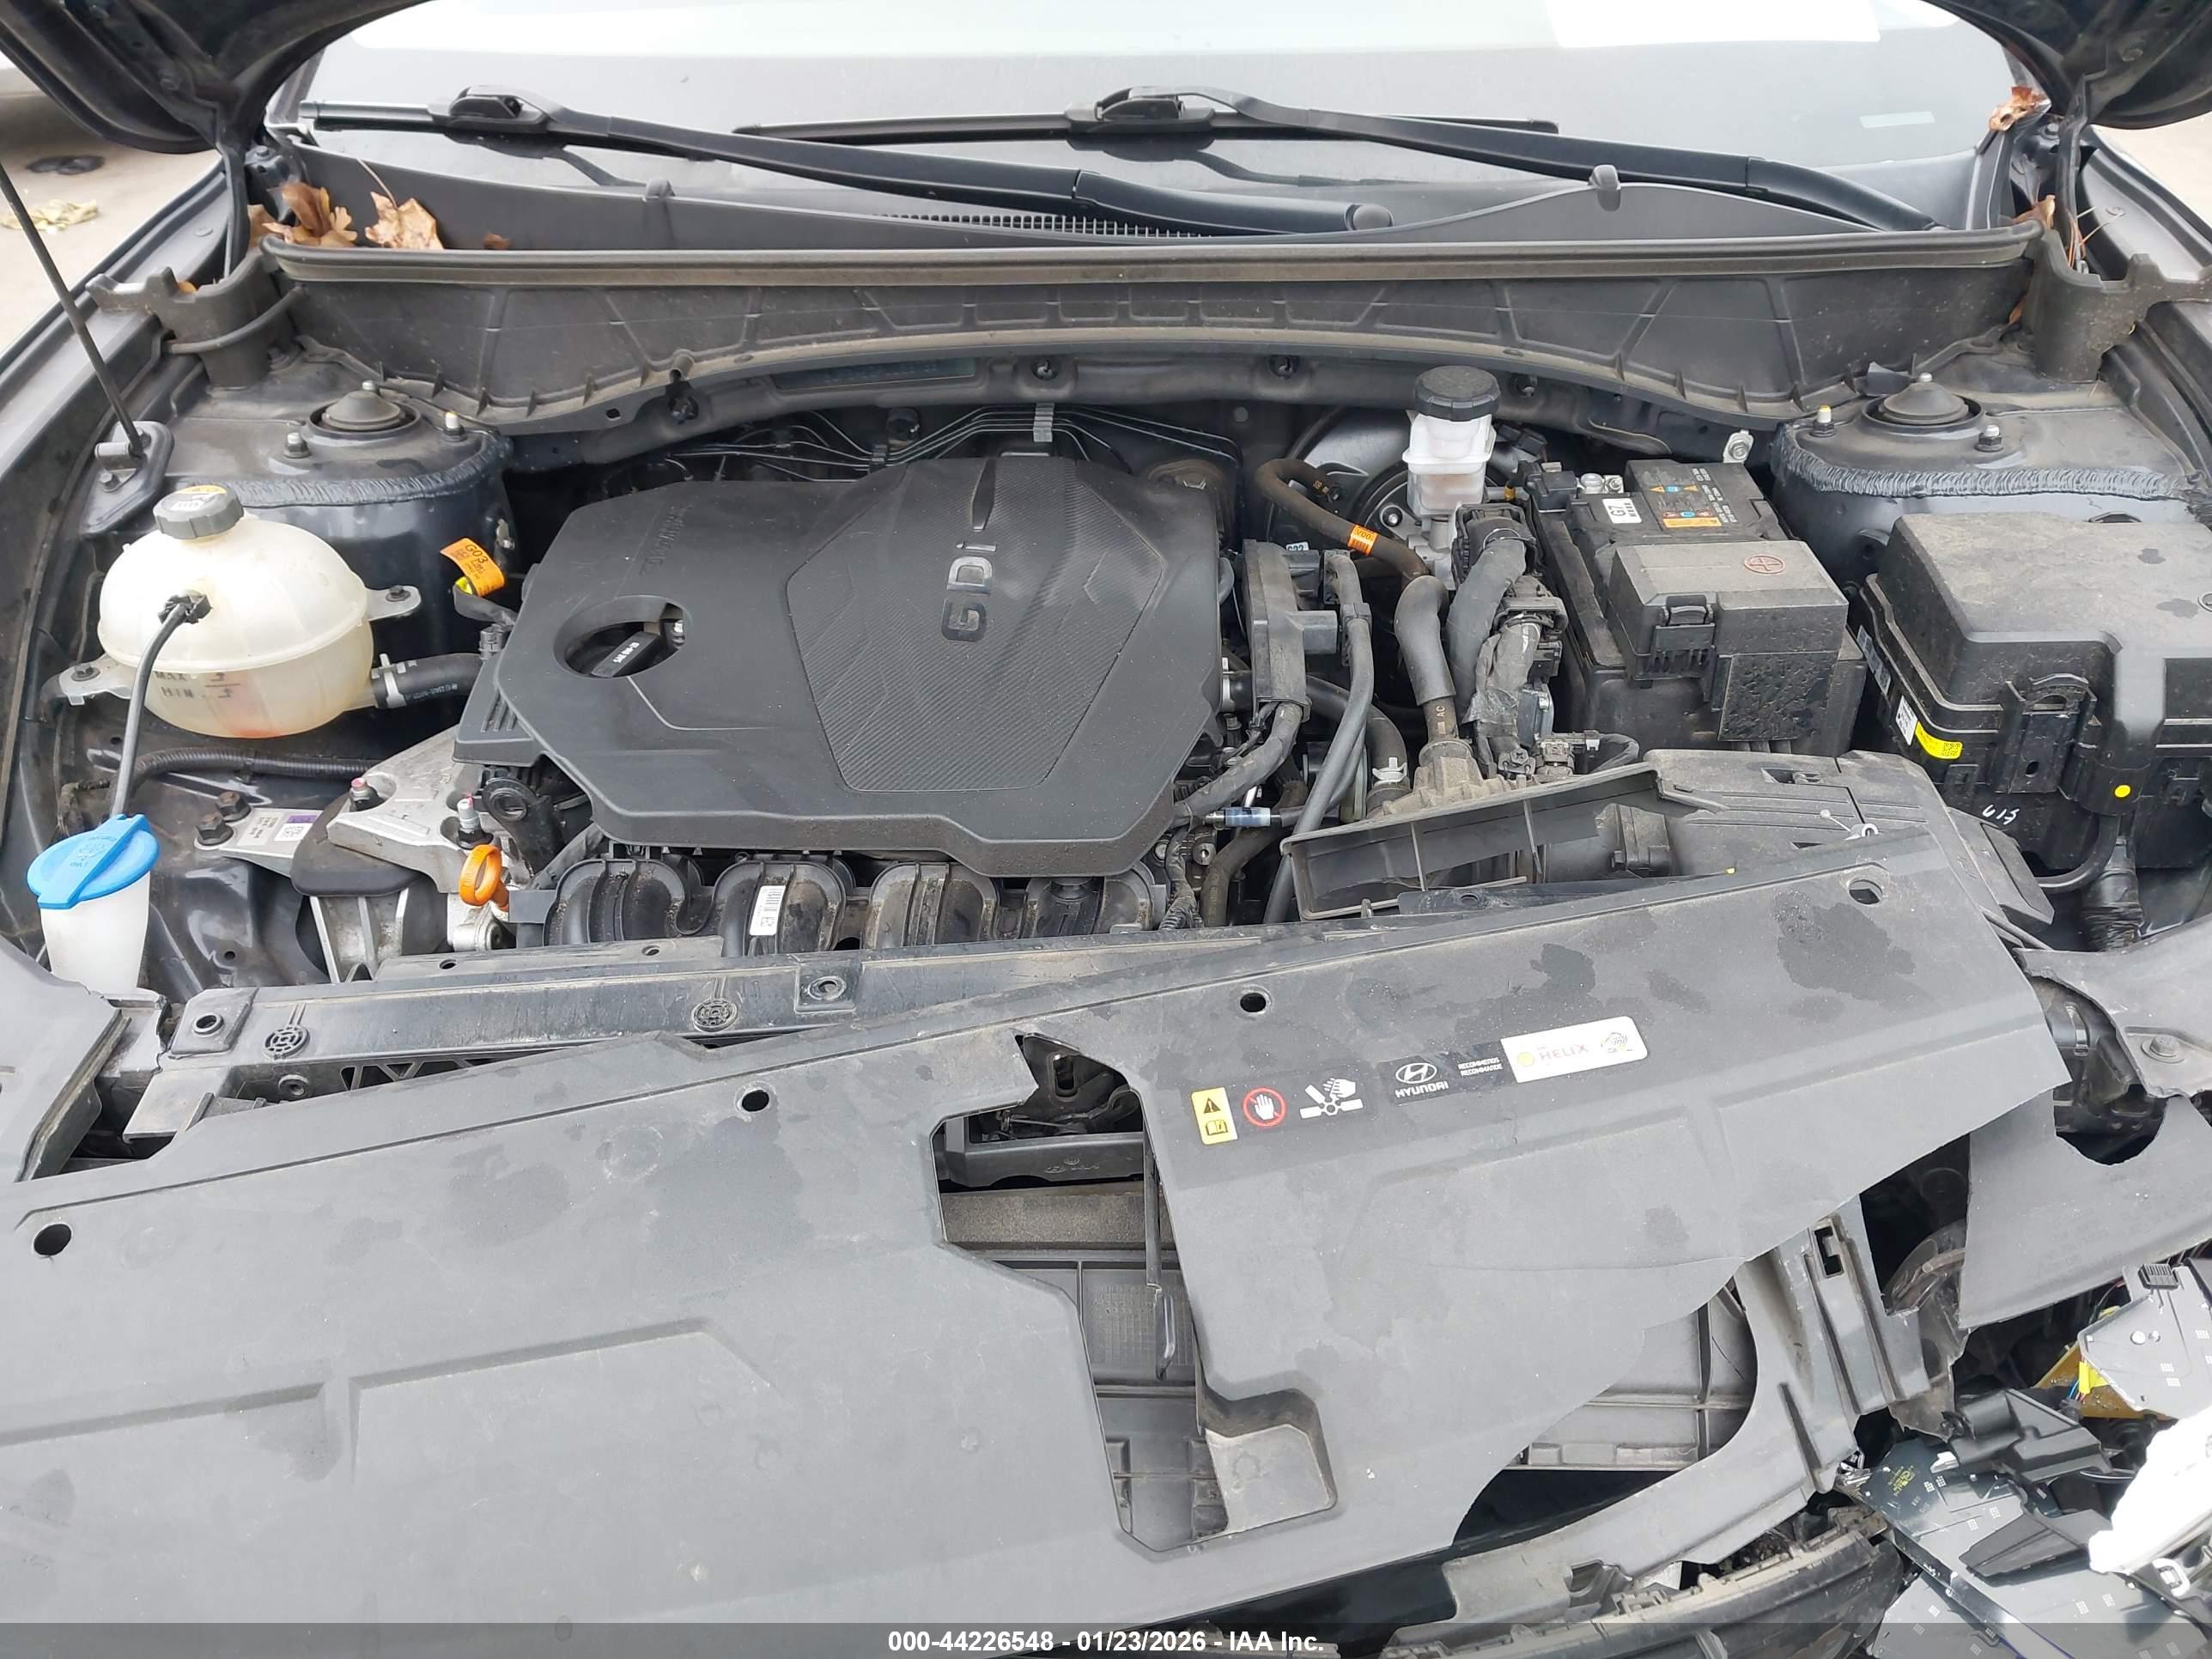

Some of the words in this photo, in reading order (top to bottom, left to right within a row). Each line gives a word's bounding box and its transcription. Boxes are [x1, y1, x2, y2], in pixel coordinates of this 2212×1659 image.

[1607, 505, 1626, 516] G7
[465, 544, 489, 564] G03
[941, 543, 997, 641] GDi
[155, 671, 186, 682] MAX
[1436, 705, 1446, 717] AC
[1539, 1044, 1589, 1060] HELIX
[1395, 1081, 1449, 1098] HYUNDAI
